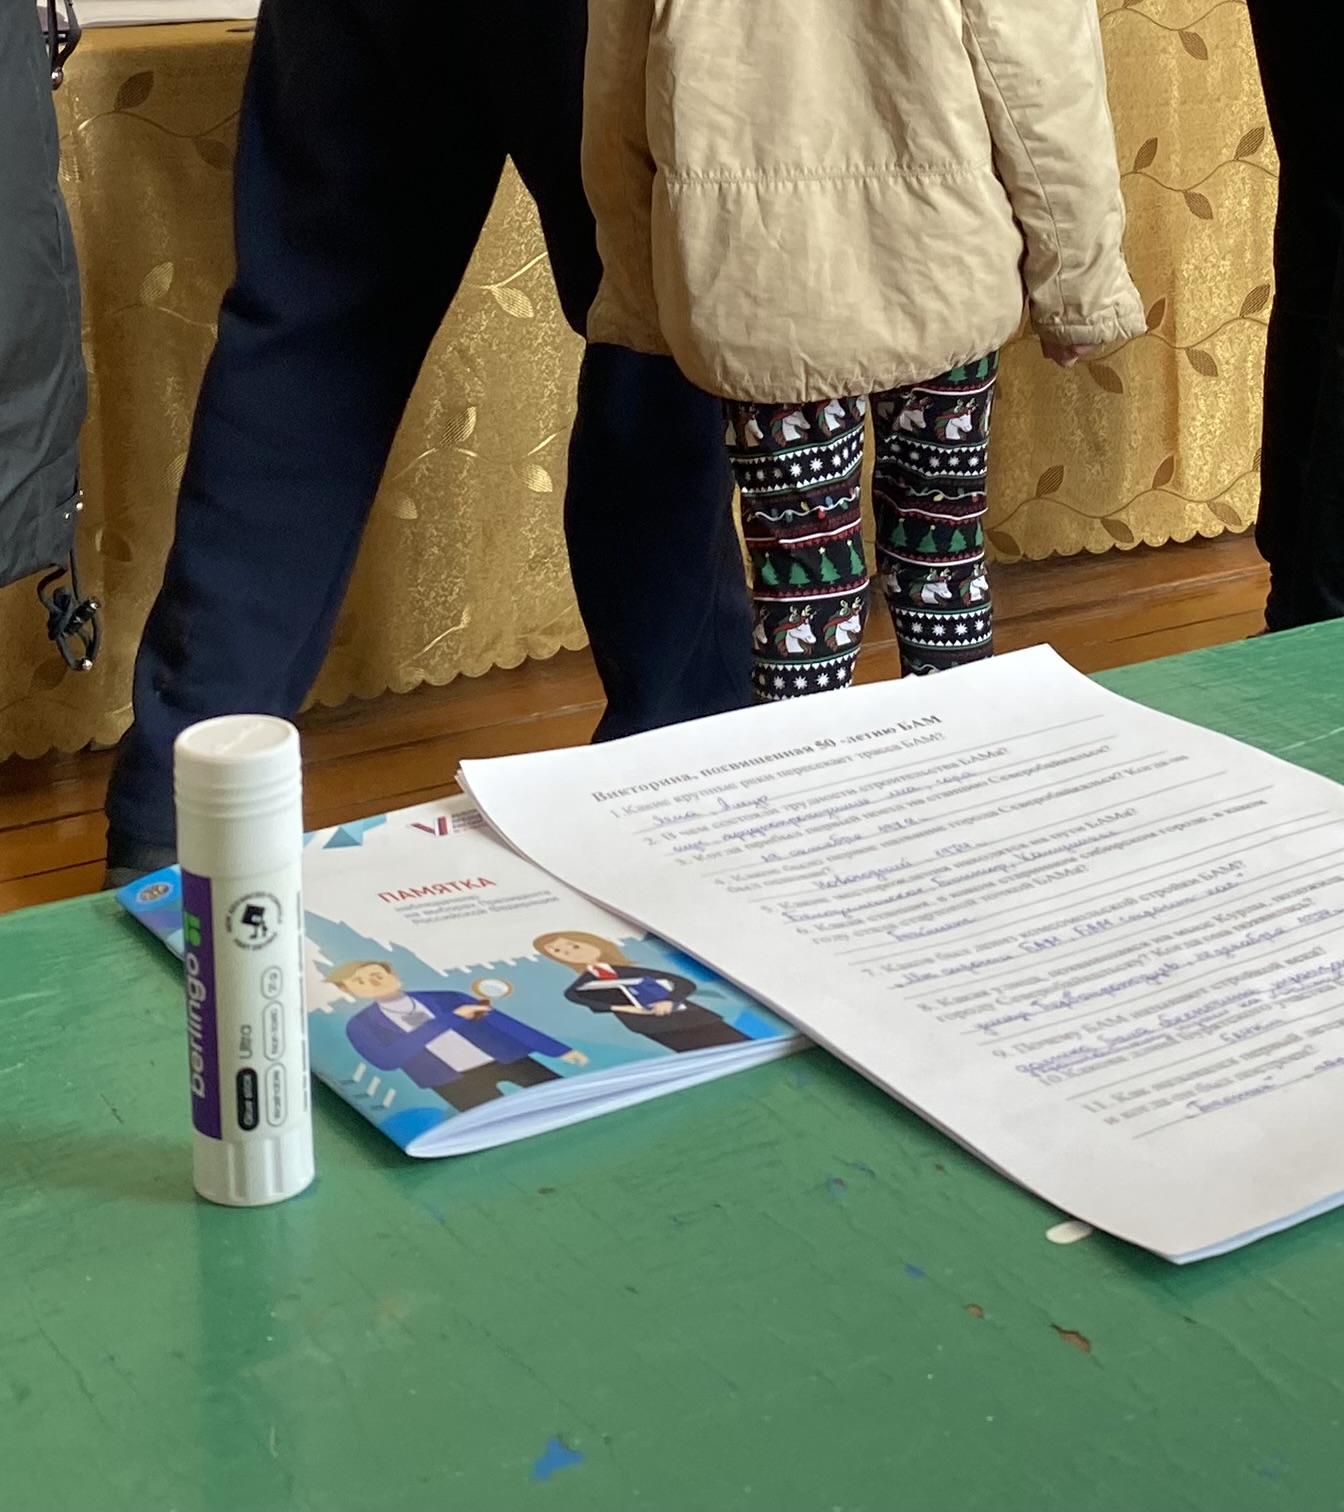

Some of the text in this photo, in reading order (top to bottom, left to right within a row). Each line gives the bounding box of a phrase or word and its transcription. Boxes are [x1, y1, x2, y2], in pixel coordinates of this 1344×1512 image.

[901, 732, 945, 746] БАМ?
[593, 771, 694, 801] Викторина,
[897, 715, 940, 730] БАМ
[959, 747, 1010, 764] БАМа?
[1198, 860, 1248, 879] БАМ?
[377, 876, 497, 903] ПАМЯТКА
[185, 951, 206, 1099] berlingo
[1081, 1015, 1128, 1032] БАМ
[239, 1024, 253, 1060] Ultra
